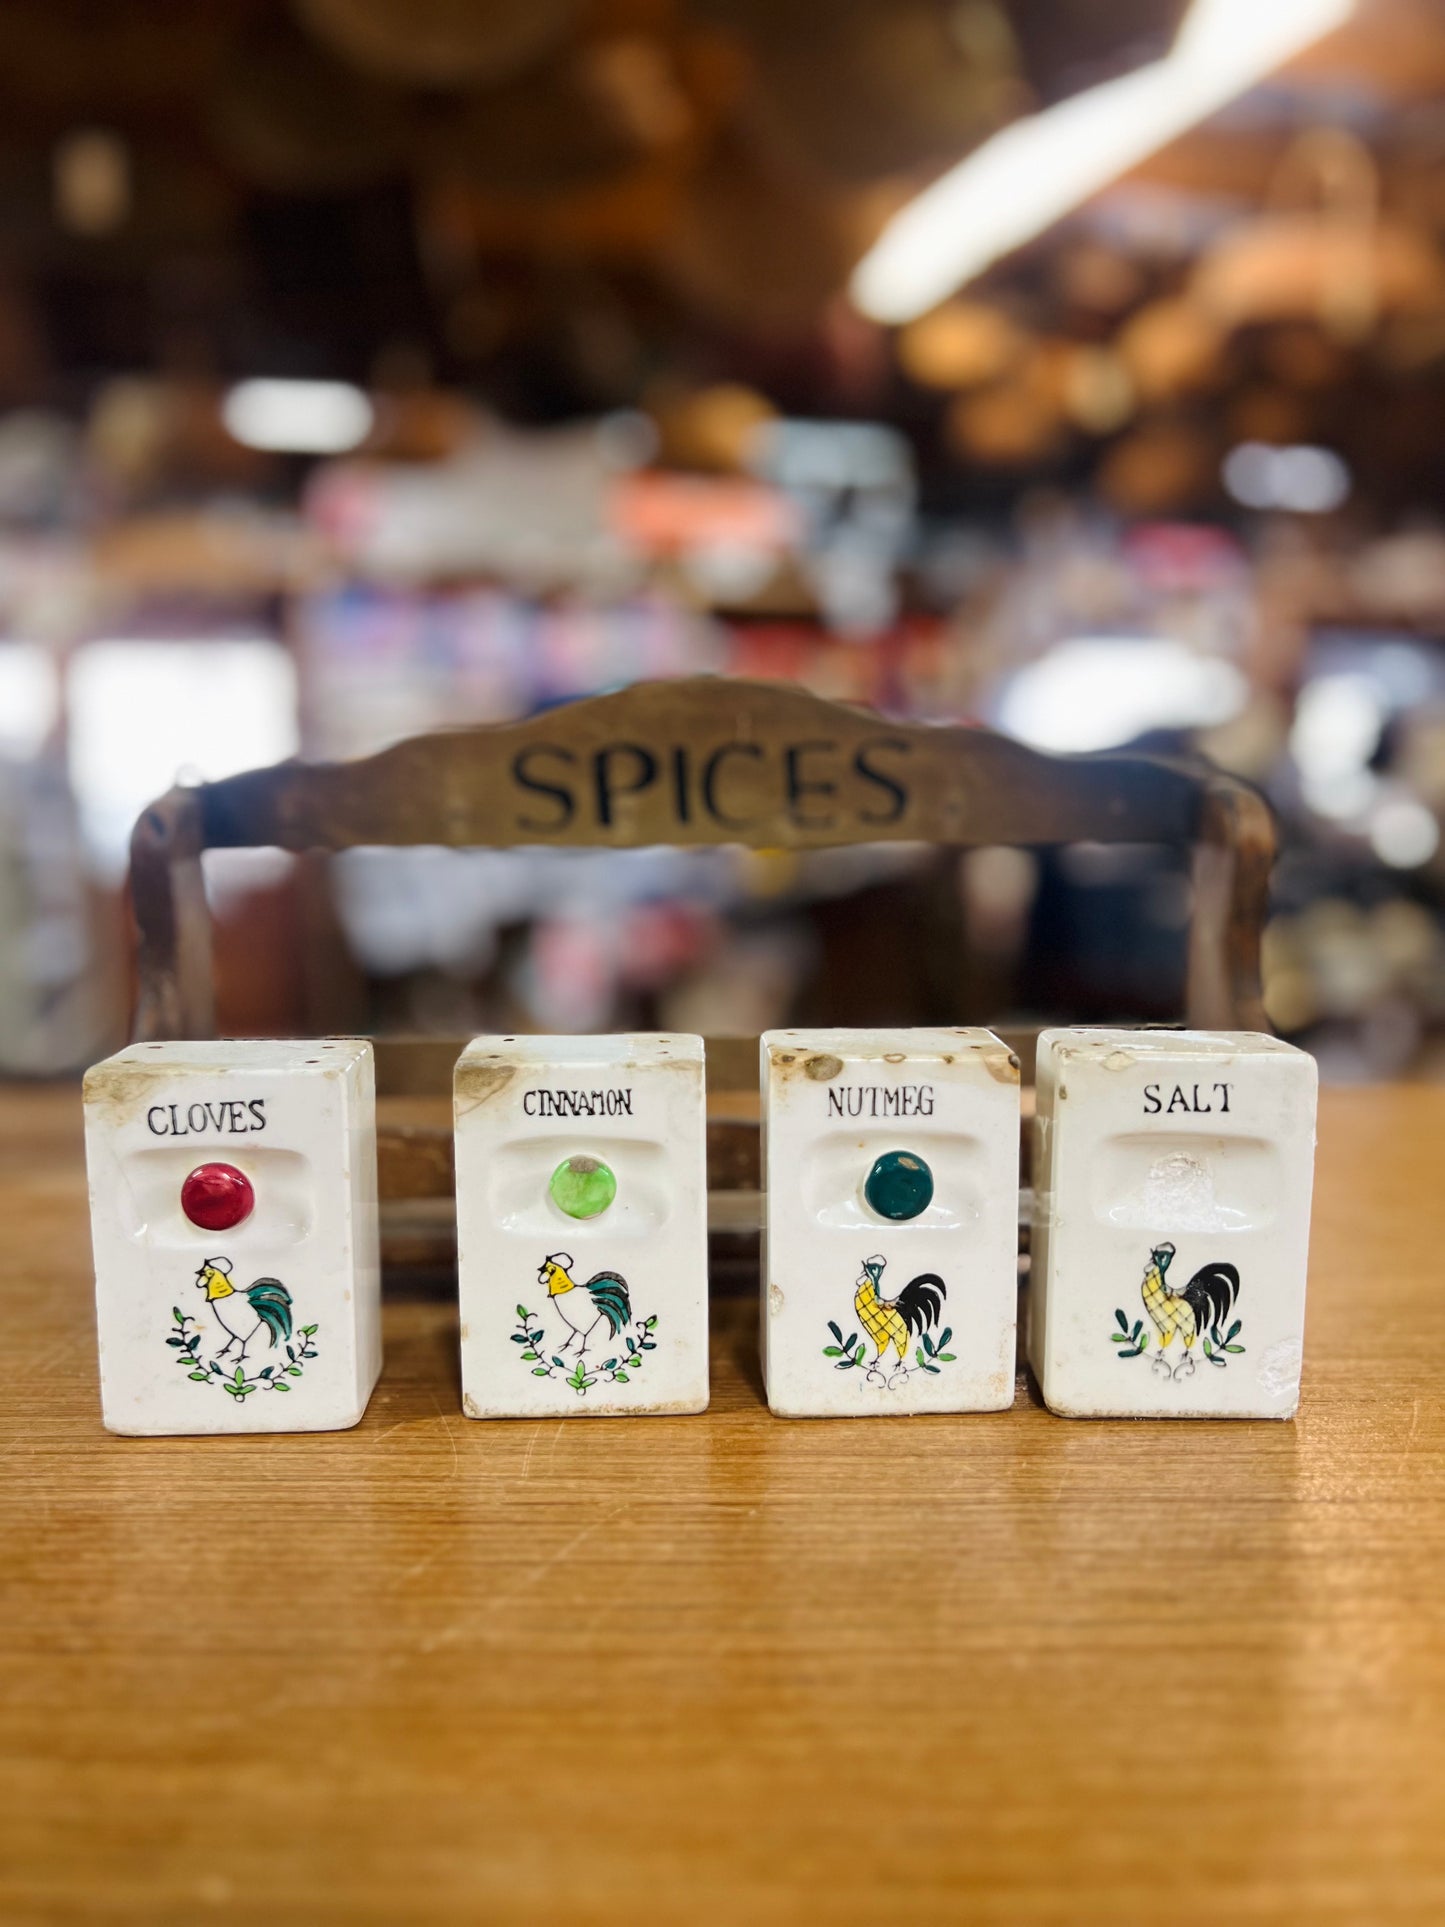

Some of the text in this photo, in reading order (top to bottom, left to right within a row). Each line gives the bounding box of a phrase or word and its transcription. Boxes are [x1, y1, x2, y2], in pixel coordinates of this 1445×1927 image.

[510, 737, 912, 832] SPICES
[523, 1088, 633, 1117] CINNAMON
[827, 1085, 936, 1118] NUTMEG
[1143, 1083, 1234, 1114] SALT
[147, 1099, 268, 1136] CLOVES
